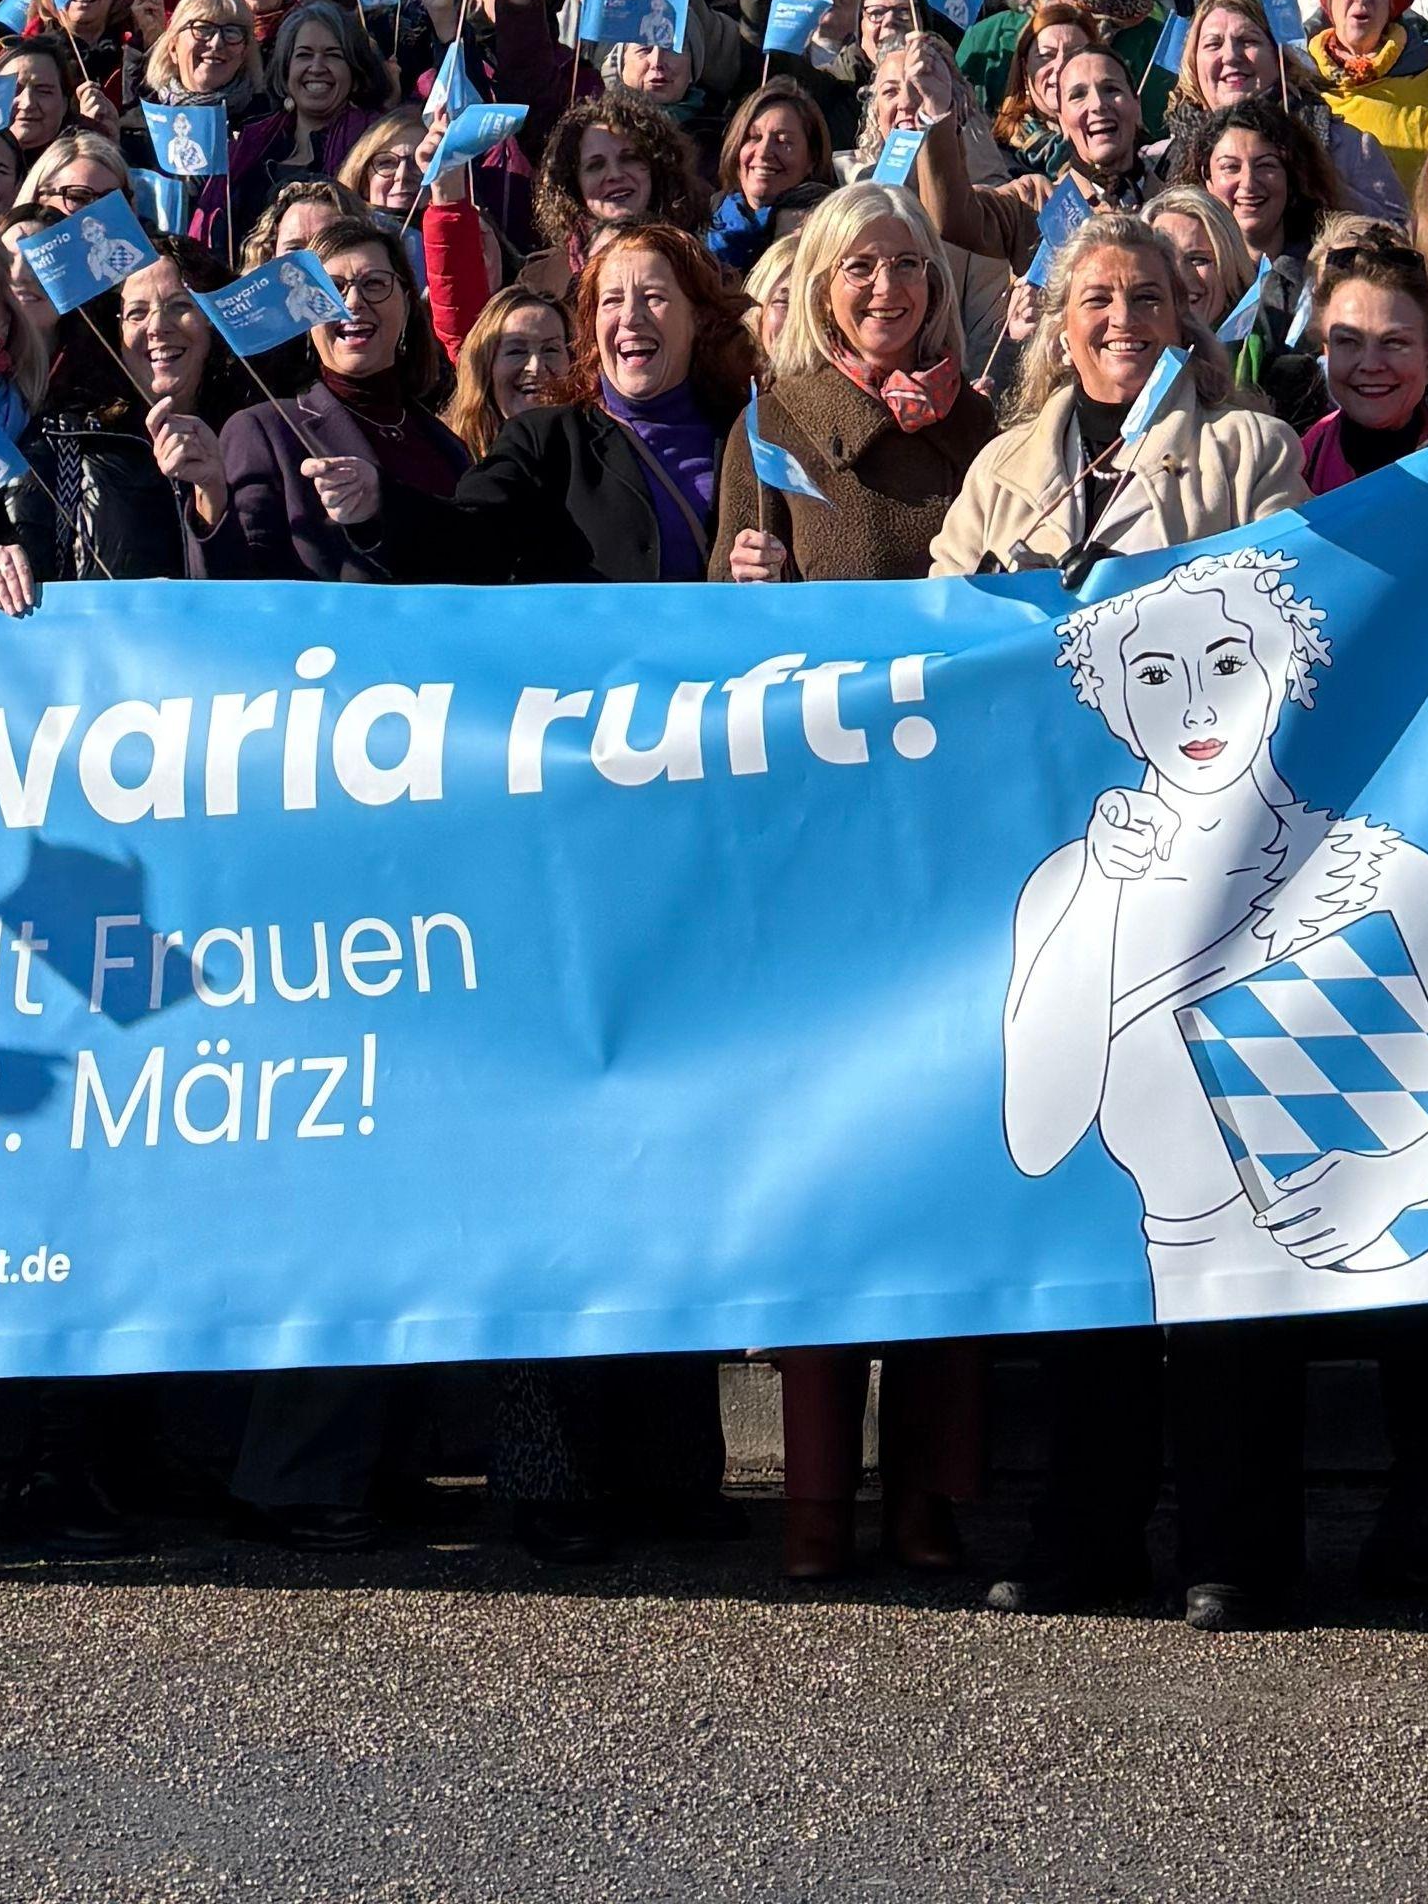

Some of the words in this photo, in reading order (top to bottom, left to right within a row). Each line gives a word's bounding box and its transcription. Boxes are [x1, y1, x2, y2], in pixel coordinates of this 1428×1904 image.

[508, 652, 946, 794] ruft!
[89, 912, 478, 1014] Frauen
[71, 1033, 376, 1149] März!
